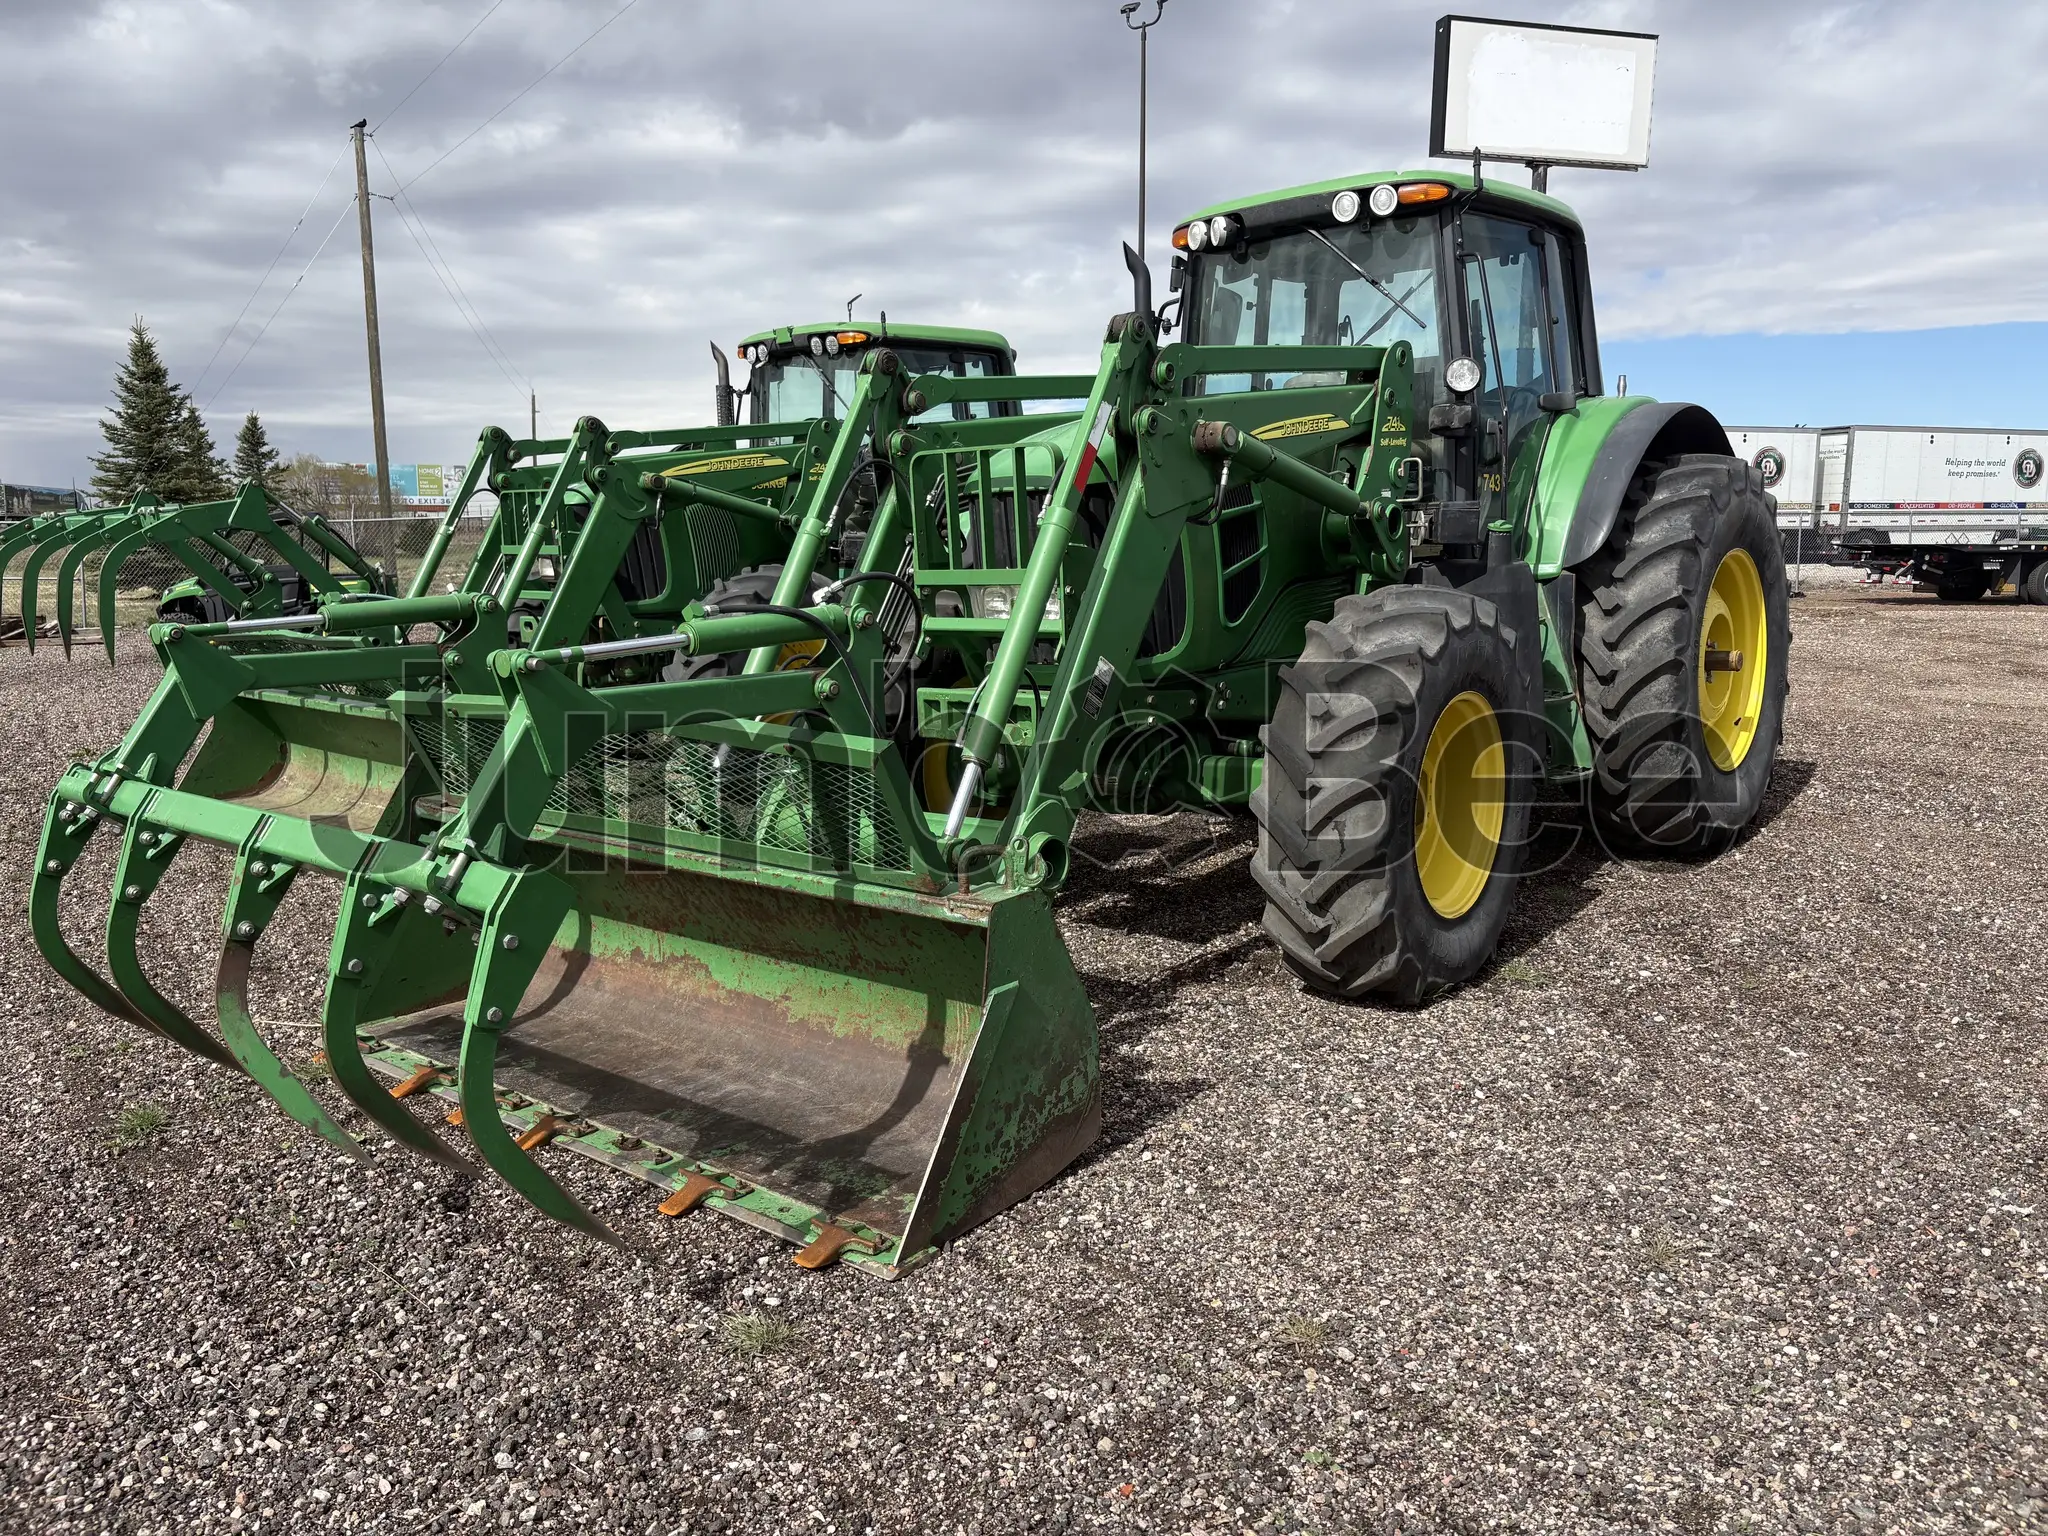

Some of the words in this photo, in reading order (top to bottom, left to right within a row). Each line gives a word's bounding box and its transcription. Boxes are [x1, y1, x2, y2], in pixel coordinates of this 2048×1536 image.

[1281, 421, 1303, 435] JOHN
[1303, 418, 1330, 432] DEERE
[706, 460, 731, 471] JOHN
[731, 457, 765, 468] DEERE
[1945, 457, 1972, 467] Helping
[1974, 458, 1984, 466] the
[1986, 459, 2006, 467] world
[1947, 468, 1965, 478] keep
